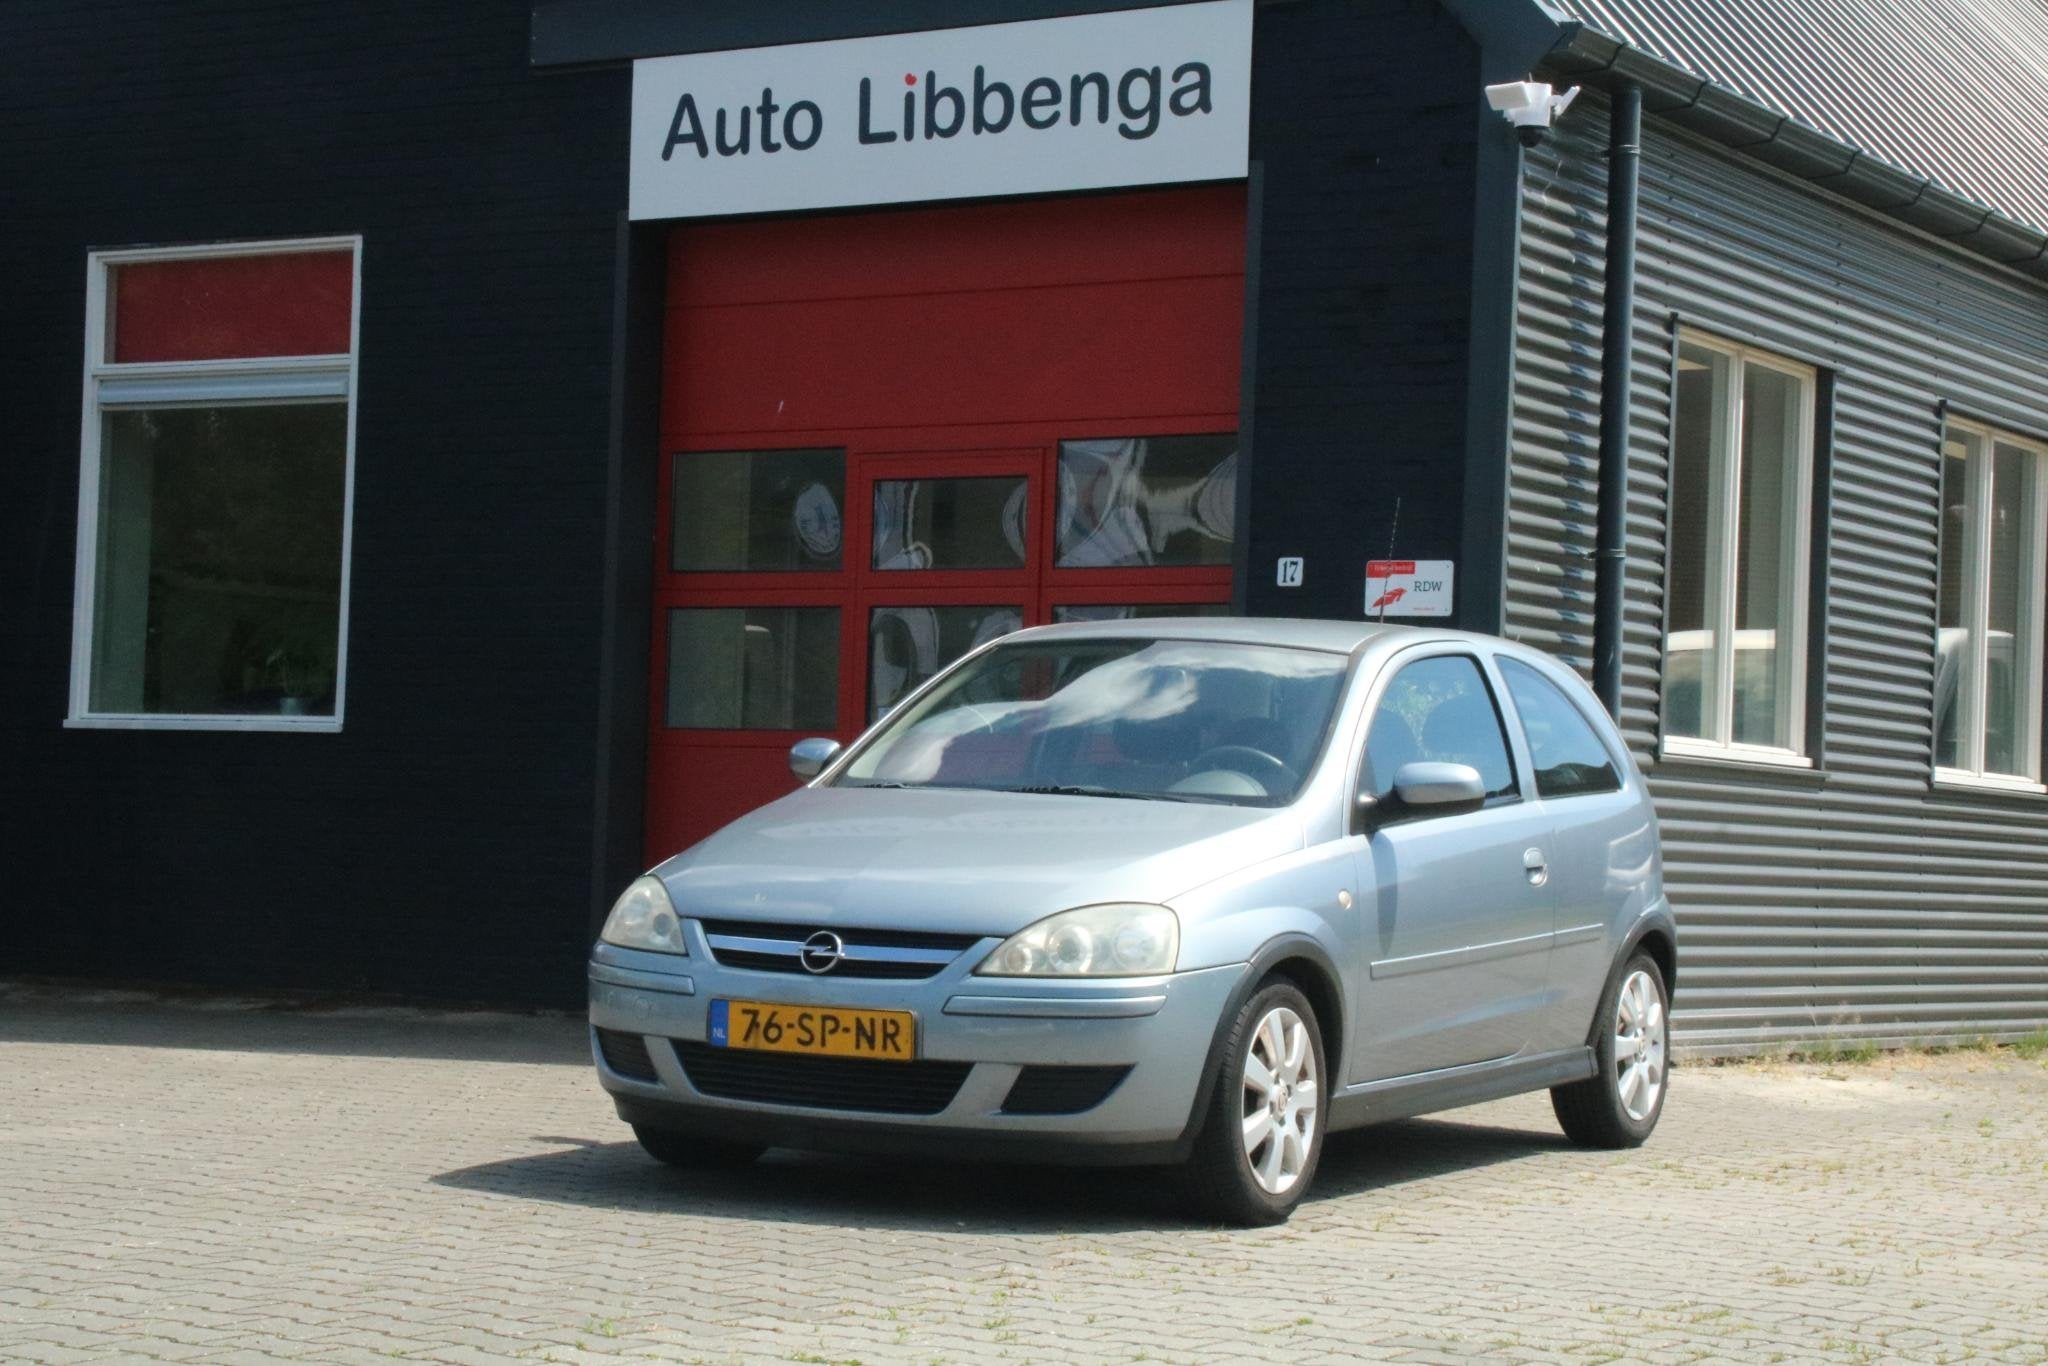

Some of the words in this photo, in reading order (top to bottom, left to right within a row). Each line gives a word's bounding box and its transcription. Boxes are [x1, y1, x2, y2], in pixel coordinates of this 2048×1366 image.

[661, 87, 823, 161] Auto
[857, 61, 1213, 145] Libbenga
[1281, 560, 1299, 583] 17
[1413, 580, 1443, 593] RDW
[712, 1027, 726, 1039] NL
[740, 1008, 902, 1053] 76-SP-NR
